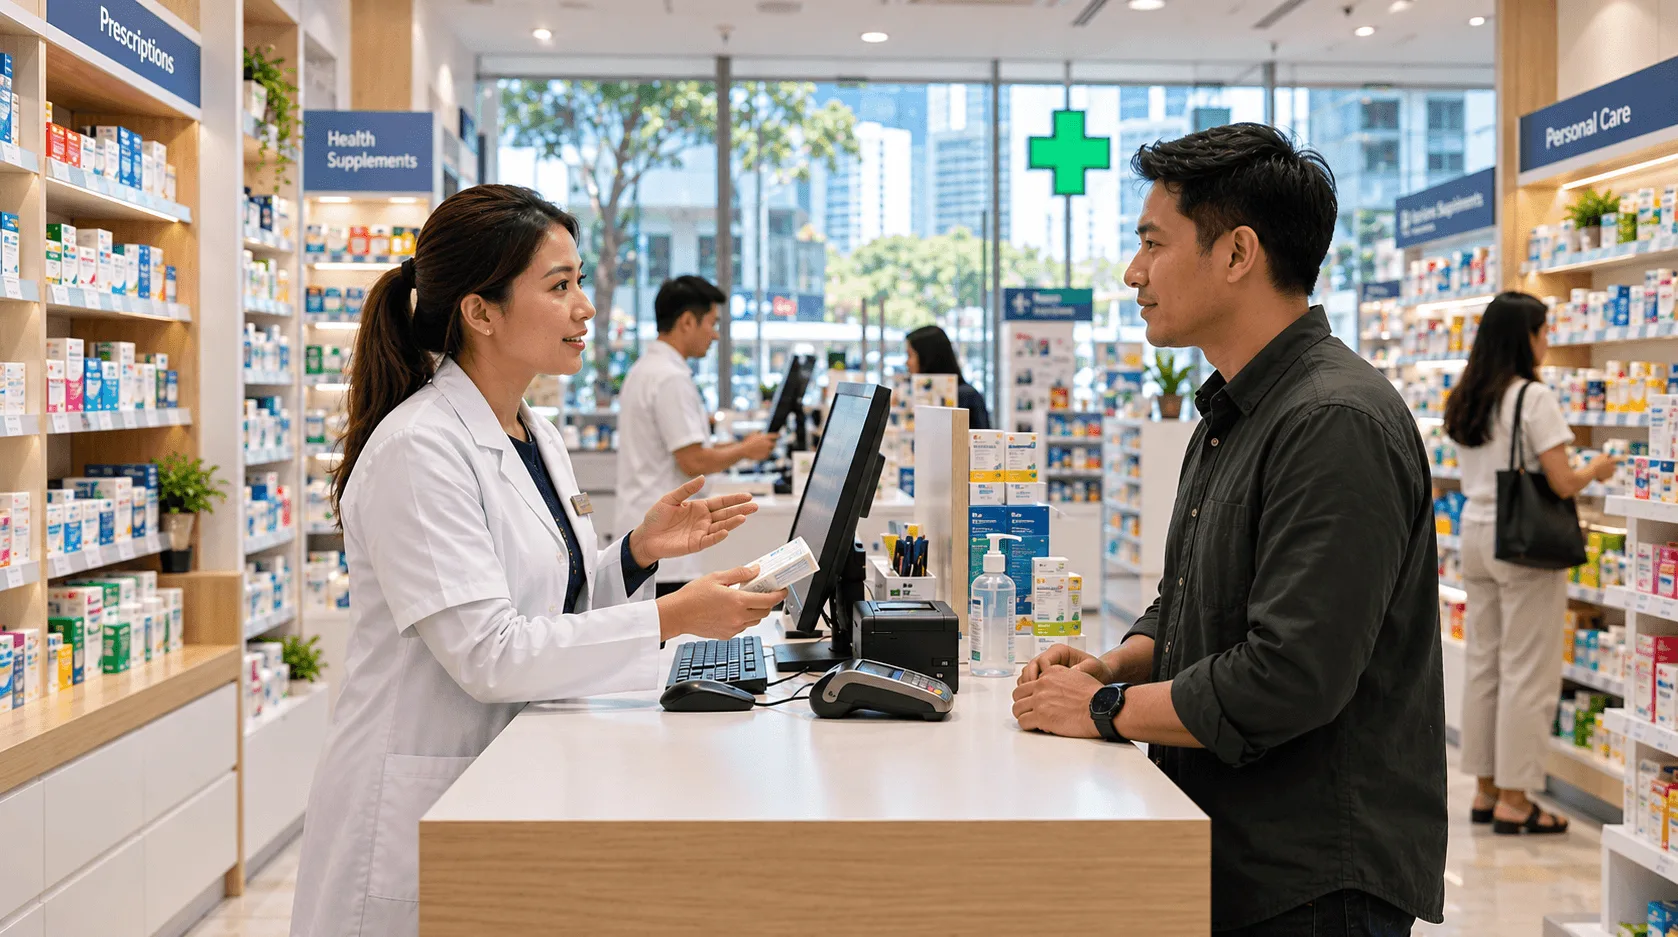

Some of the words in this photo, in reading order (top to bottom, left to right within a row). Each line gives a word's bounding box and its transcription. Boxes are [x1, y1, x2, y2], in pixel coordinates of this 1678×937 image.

[100, 5, 174, 74] Prescriptions
[327, 131, 376, 147] Health
[1546, 111, 1597, 149] Personal
[1600, 105, 1631, 130] Care
[327, 151, 418, 172] Supplements
